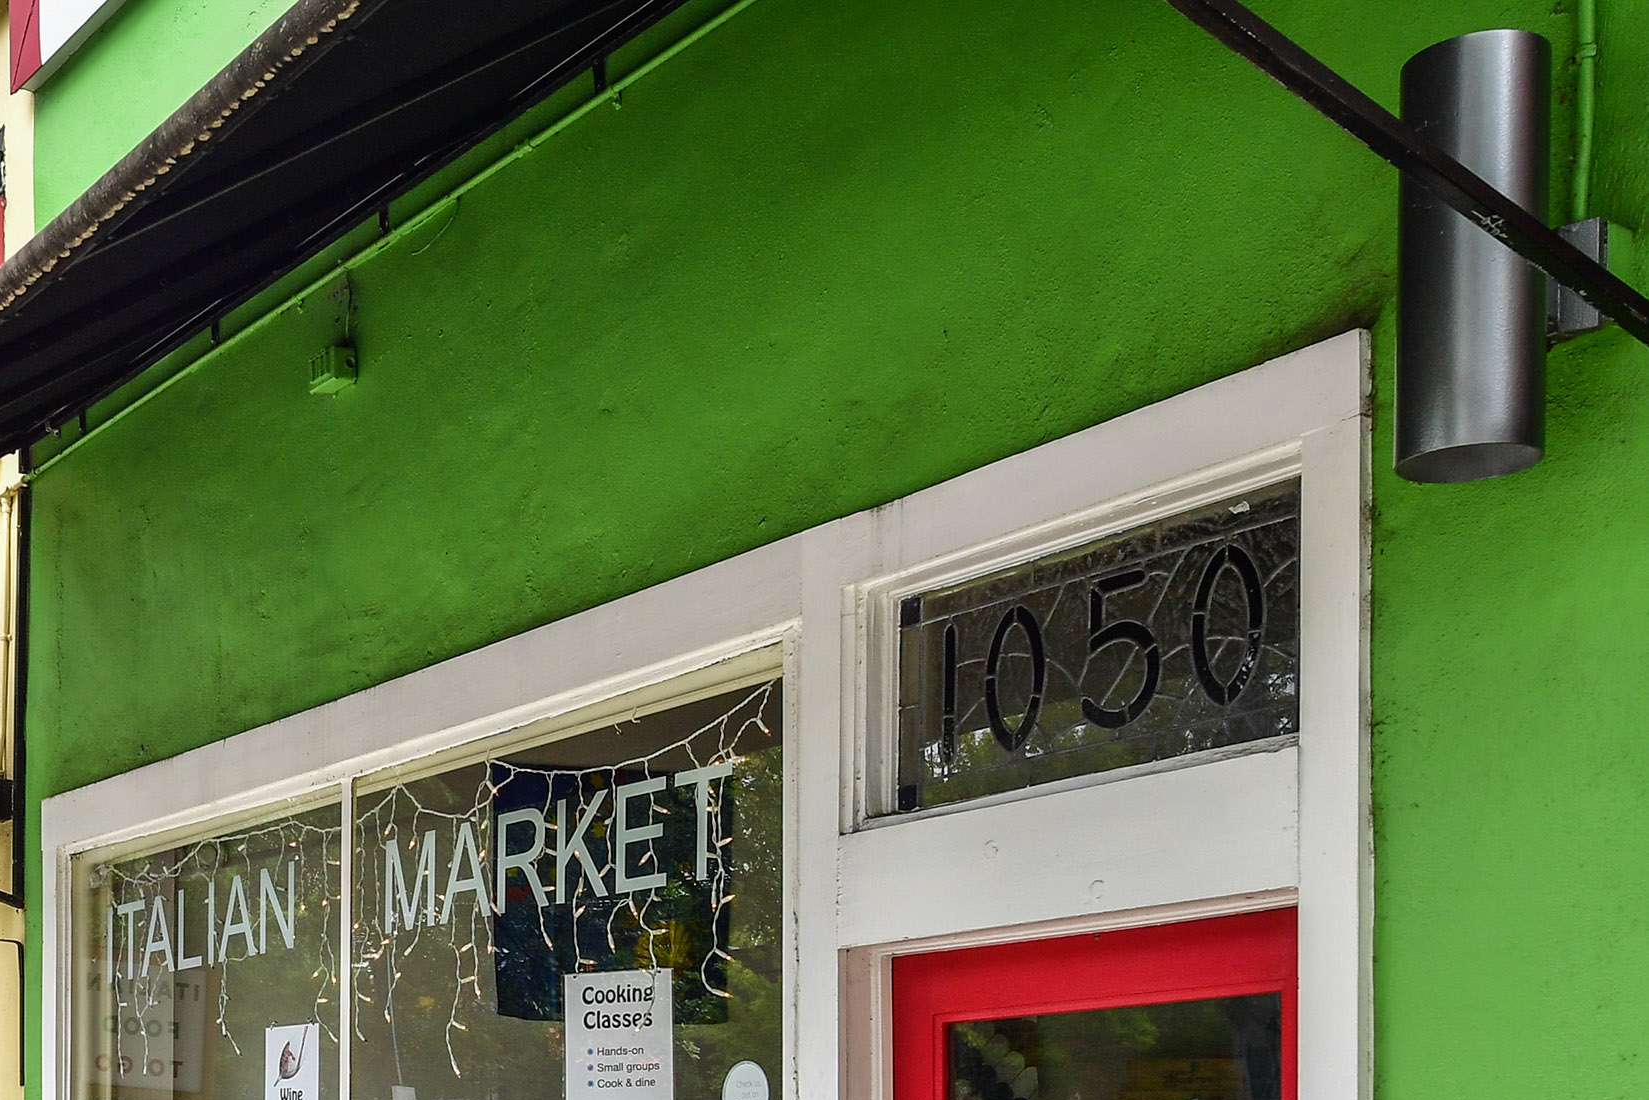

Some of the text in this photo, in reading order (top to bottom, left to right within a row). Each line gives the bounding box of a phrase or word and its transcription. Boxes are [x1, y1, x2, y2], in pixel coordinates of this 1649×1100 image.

[943, 543, 1265, 782] 1050
[107, 762, 733, 984] ITALIAN MARKET
[581, 983, 654, 1005] Cooking
[583, 1010, 654, 1030] Classes
[596, 1046, 645, 1056] Hands-on
[596, 1062, 661, 1074] Small groups
[596, 1077, 657, 1089] Cook & dine
